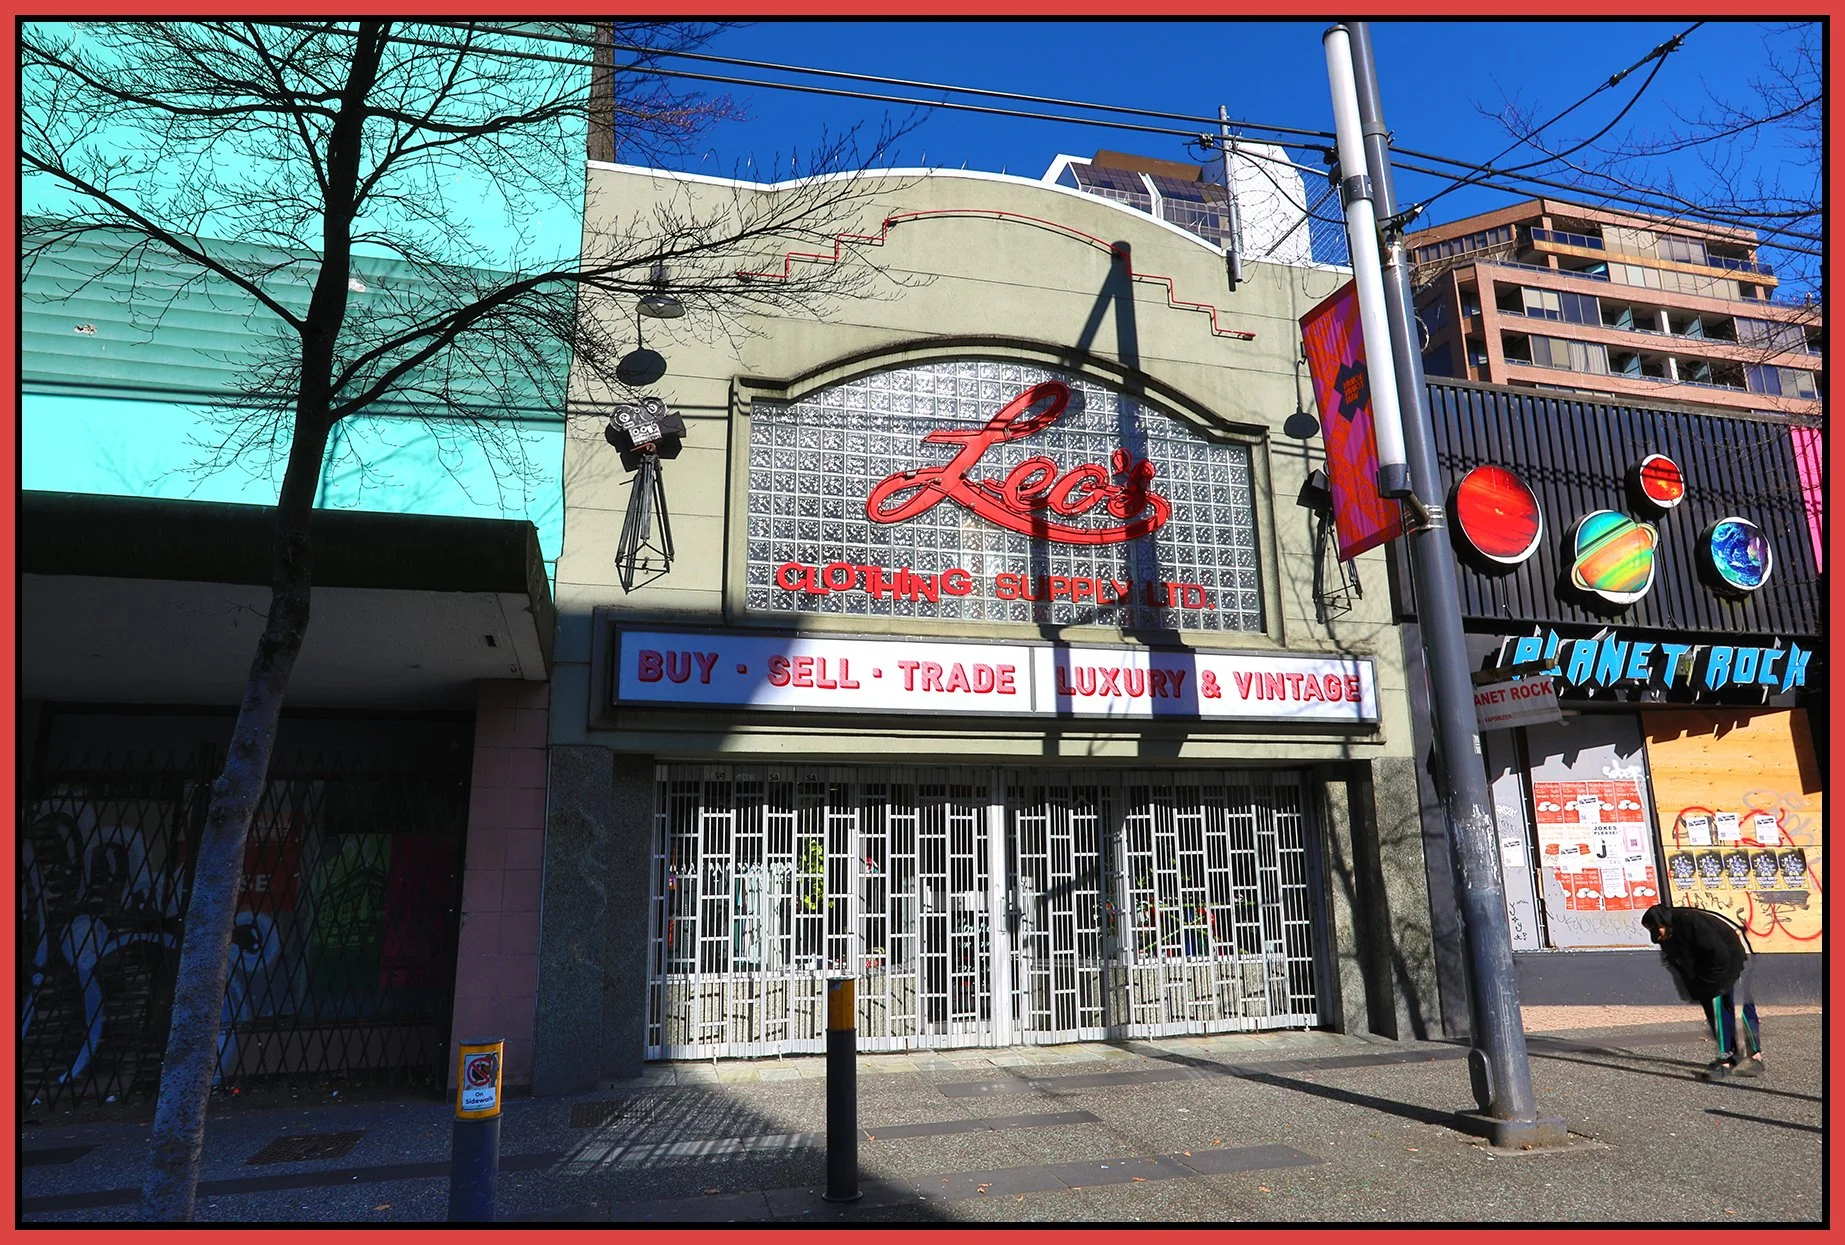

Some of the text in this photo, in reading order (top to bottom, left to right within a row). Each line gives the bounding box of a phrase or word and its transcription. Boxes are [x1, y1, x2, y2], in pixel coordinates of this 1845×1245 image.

[865, 380, 1172, 545] Leo's
[776, 561, 1216, 610] CLOTHING SUPPLY LTD.
[637, 649, 1363, 703] BUY SELL TRADE LUXURY & VINTAGE
[1511, 627, 1813, 695] PLANET ROCK
[1473, 681, 1553, 706] ANET ROCK
